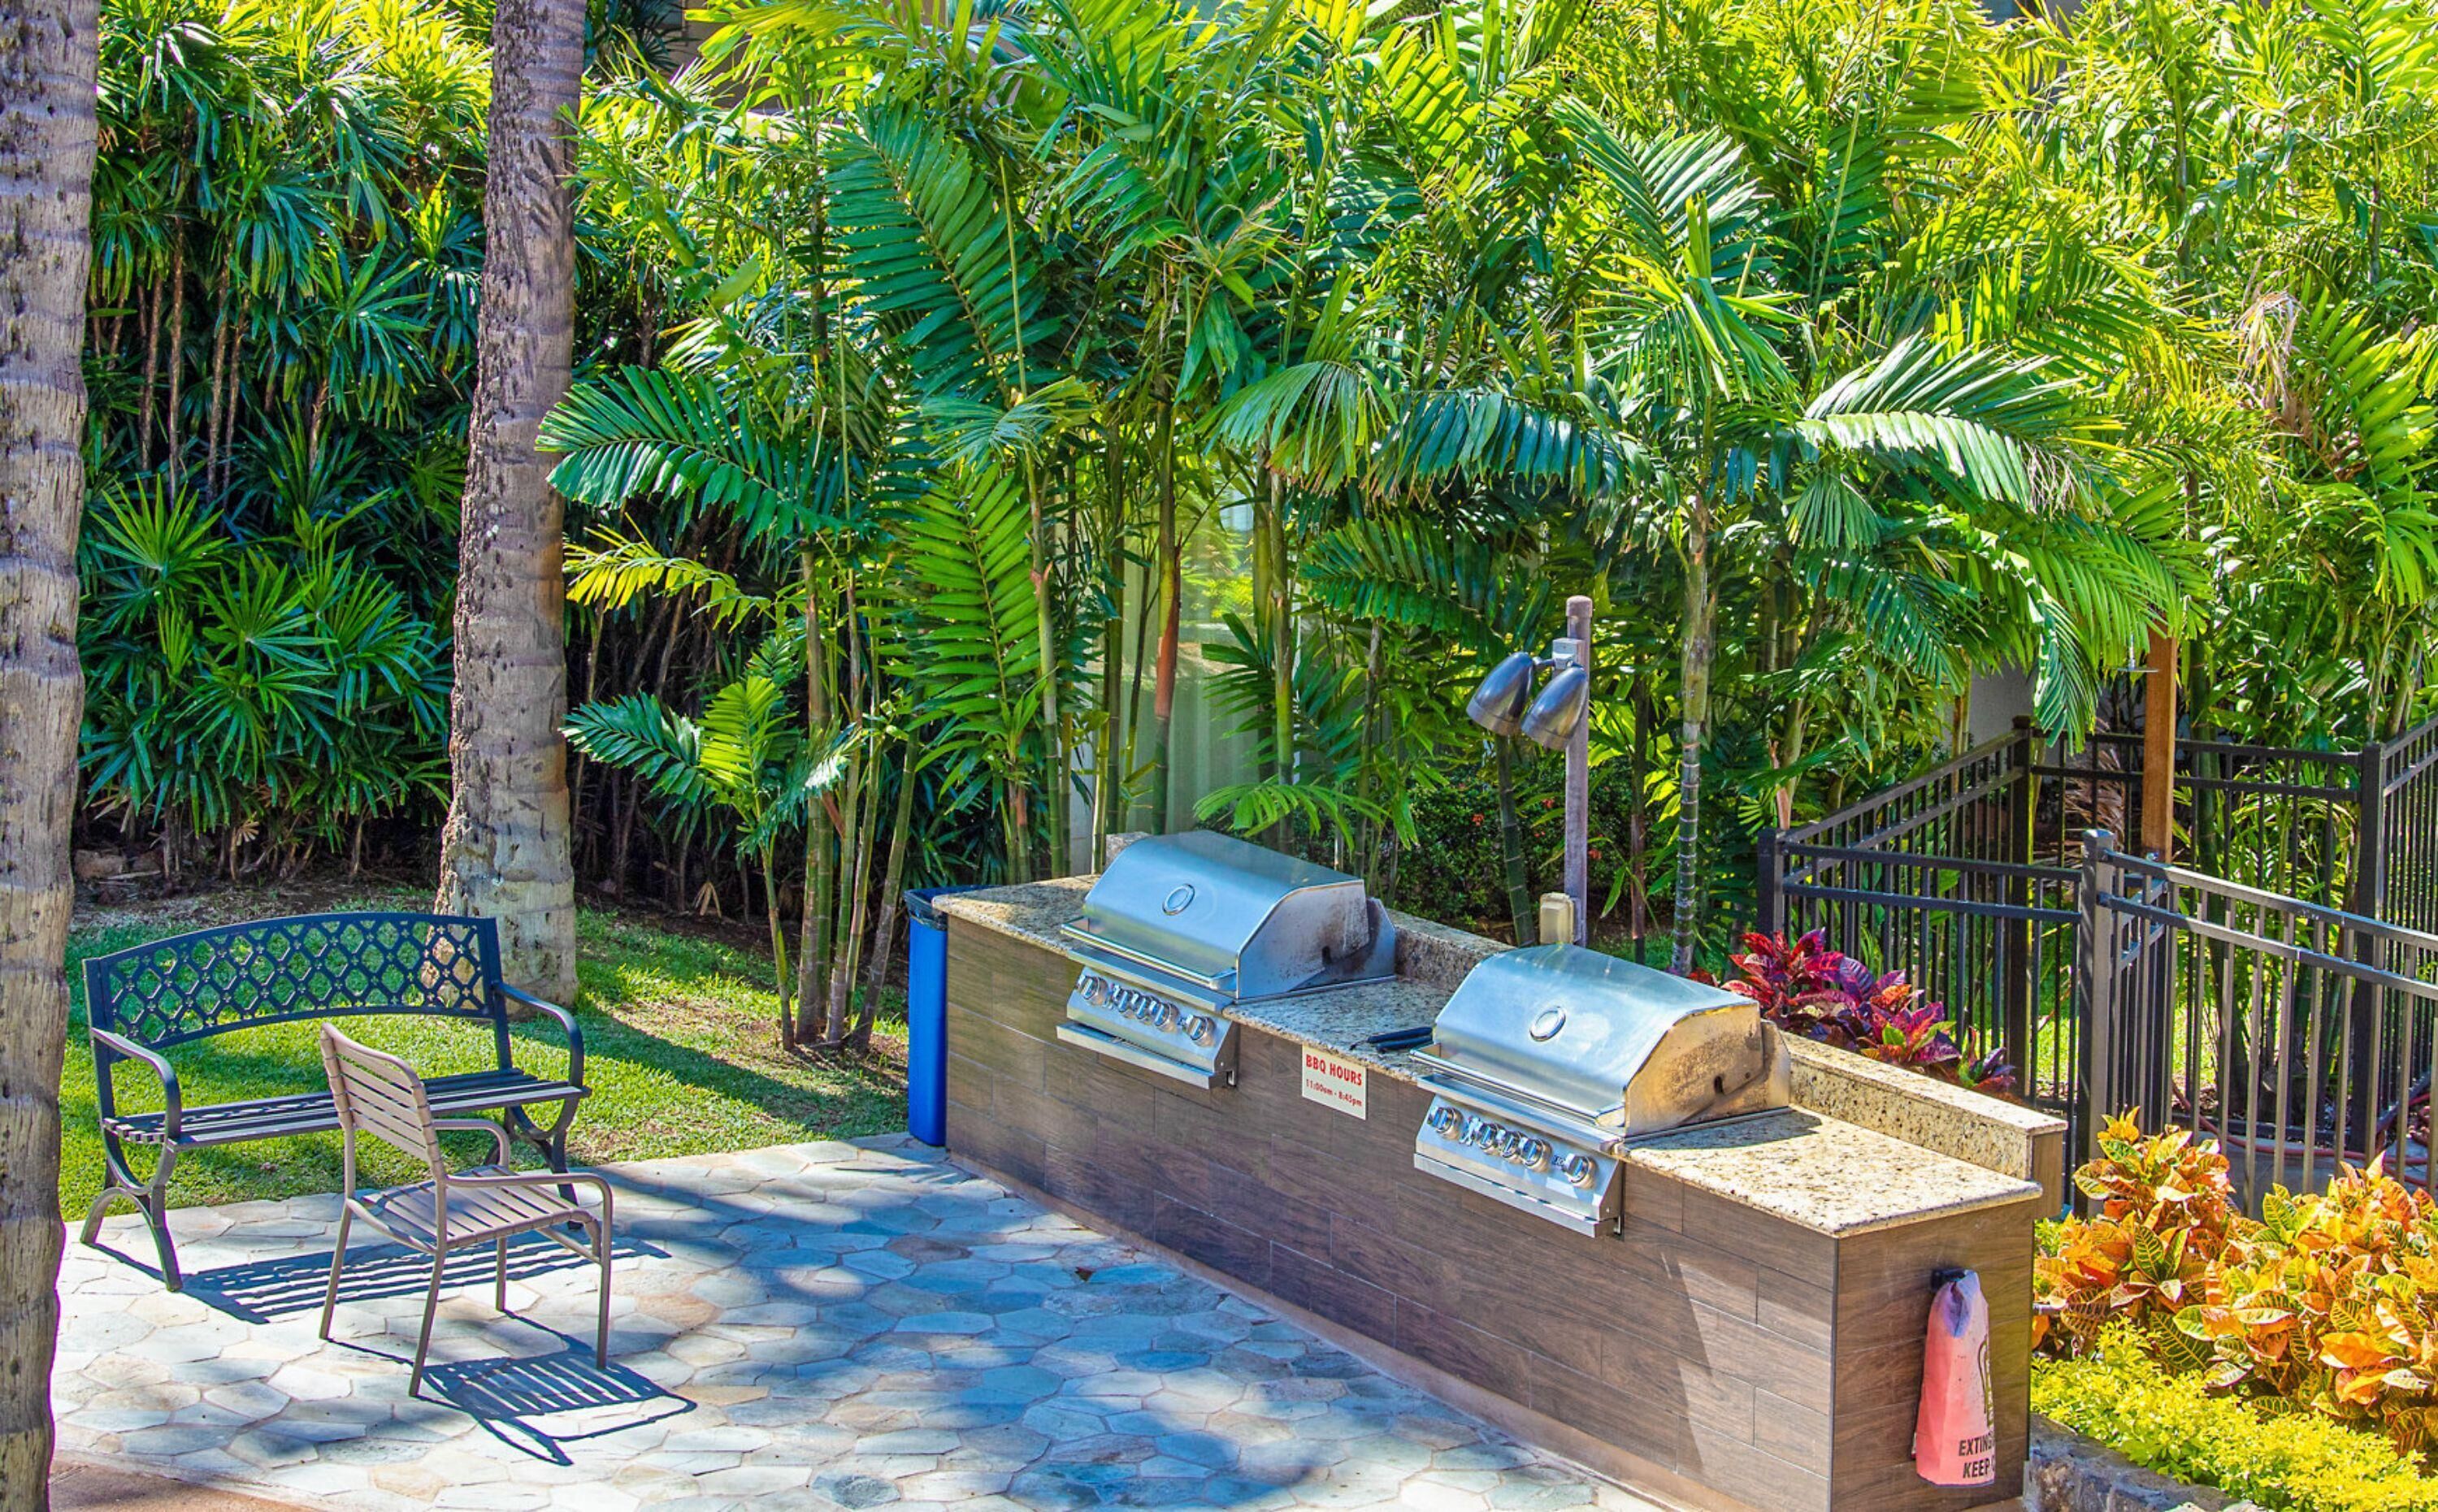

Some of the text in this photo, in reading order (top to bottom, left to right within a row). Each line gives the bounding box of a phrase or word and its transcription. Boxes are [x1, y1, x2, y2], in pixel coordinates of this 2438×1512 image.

[1306, 1054, 1362, 1085] BBQ HOURS
[1963, 1458, 1990, 1479] KEEP
